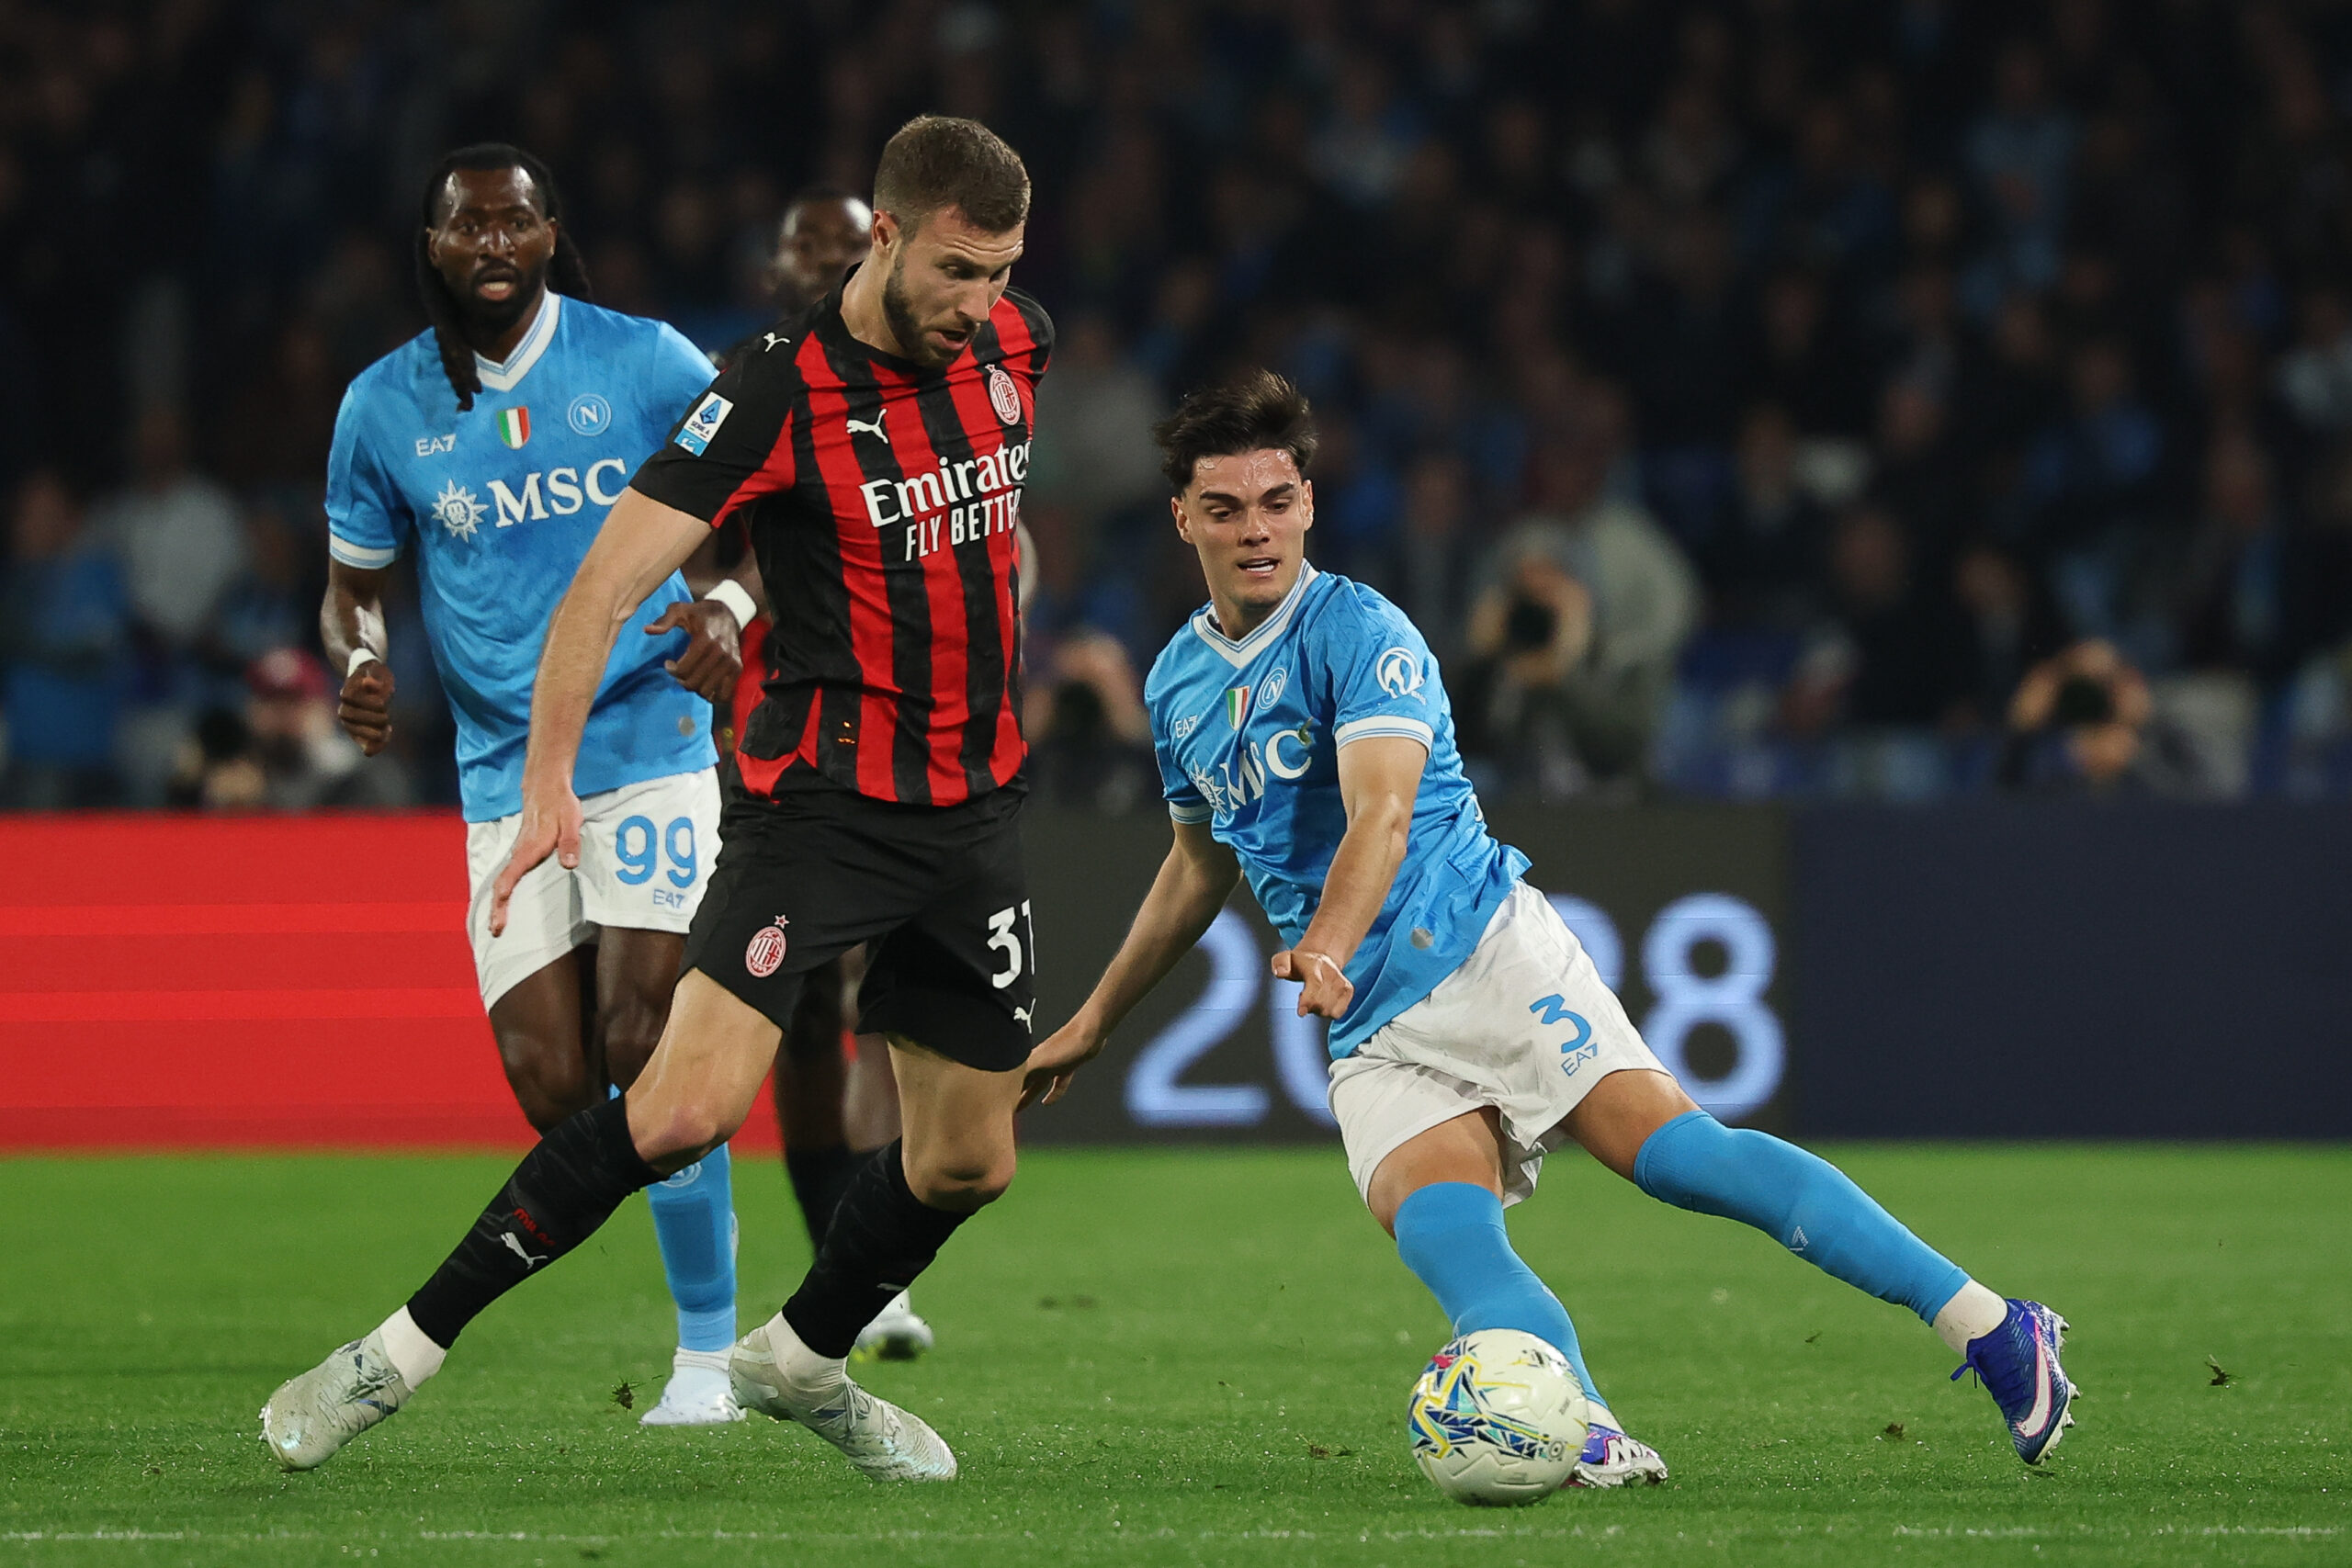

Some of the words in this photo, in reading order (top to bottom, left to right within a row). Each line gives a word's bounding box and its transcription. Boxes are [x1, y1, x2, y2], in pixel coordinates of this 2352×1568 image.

[415, 433, 457, 457] EA7
[486, 457, 629, 528] MSC
[905, 513, 943, 562] FLY
[1175, 715, 1199, 739] EA7
[615, 815, 697, 889] 99
[653, 888, 685, 909] EA7
[987, 898, 1035, 989] 31
[1528, 993, 1592, 1055] 3
[1560, 1042, 1599, 1077] EA7
